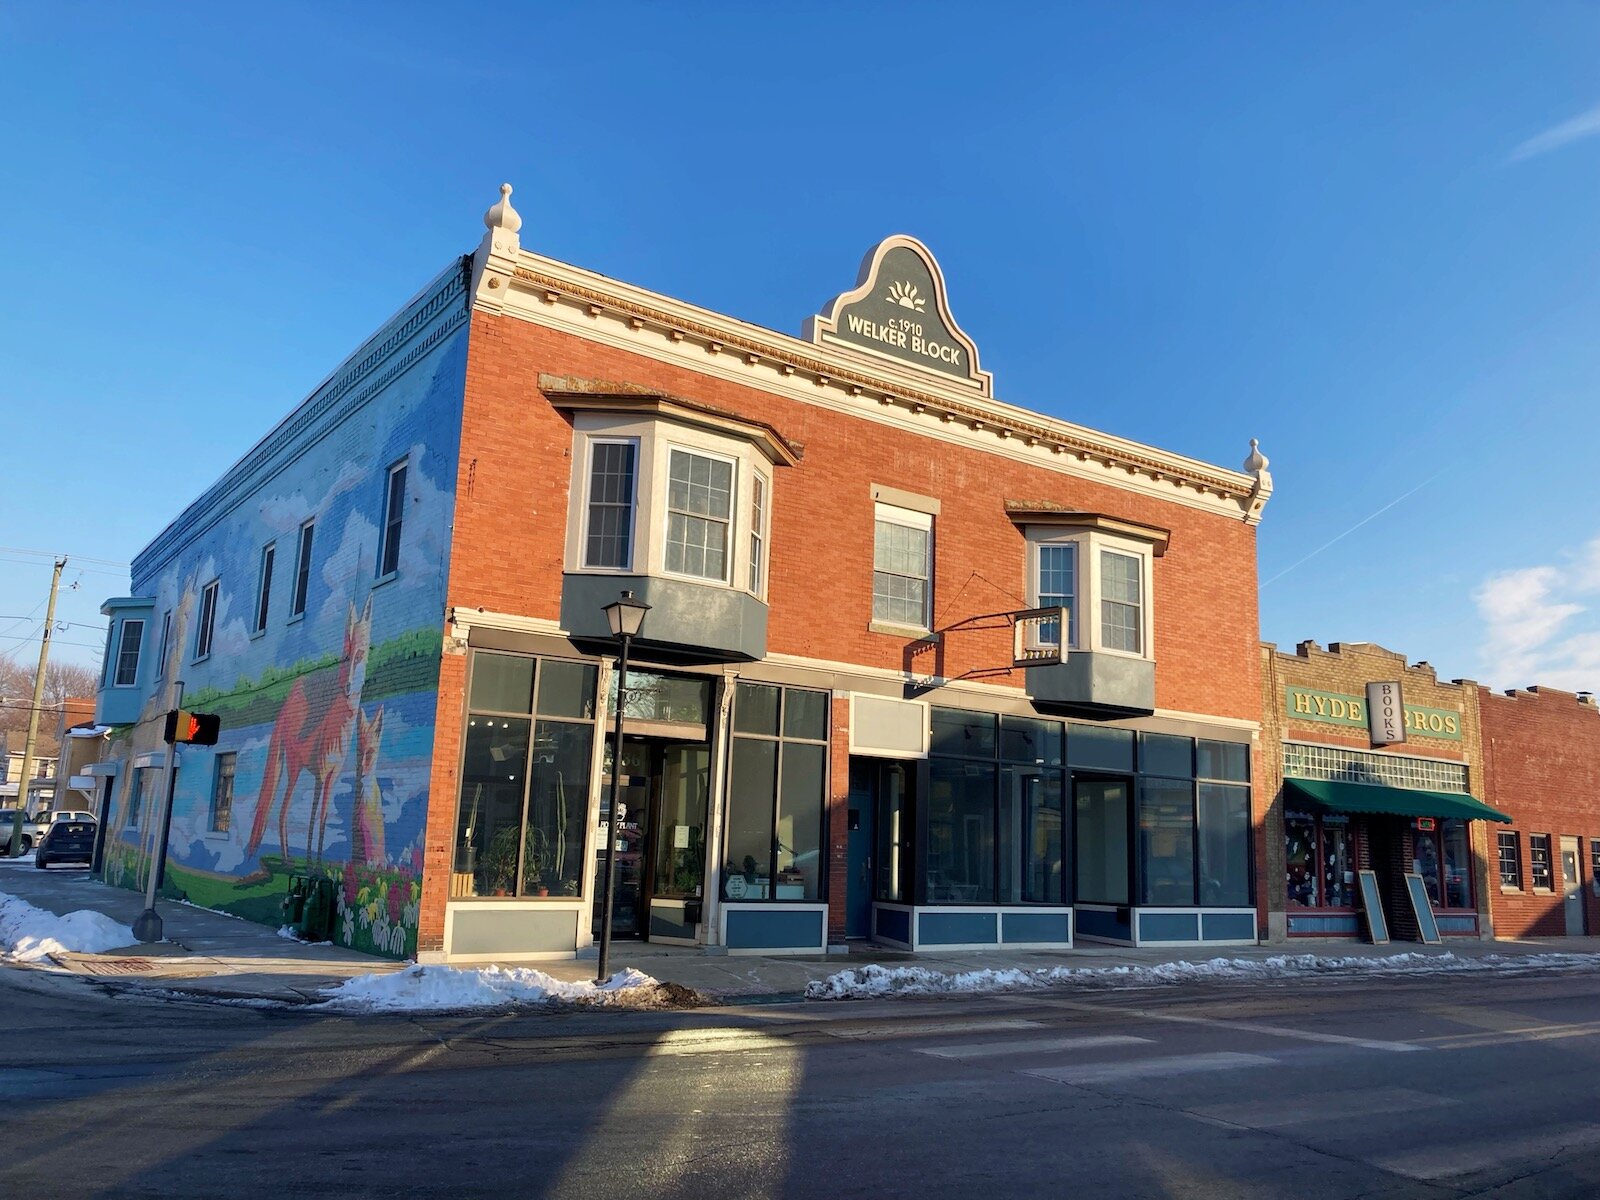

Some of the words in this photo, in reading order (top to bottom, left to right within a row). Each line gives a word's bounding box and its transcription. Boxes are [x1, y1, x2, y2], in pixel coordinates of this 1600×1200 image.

[848, 314, 906, 348] WELKER
[912, 336, 960, 365] BLOCK
[1293, 692, 1362, 721] HYDE
[1382, 685, 1396, 741] BOOKS
